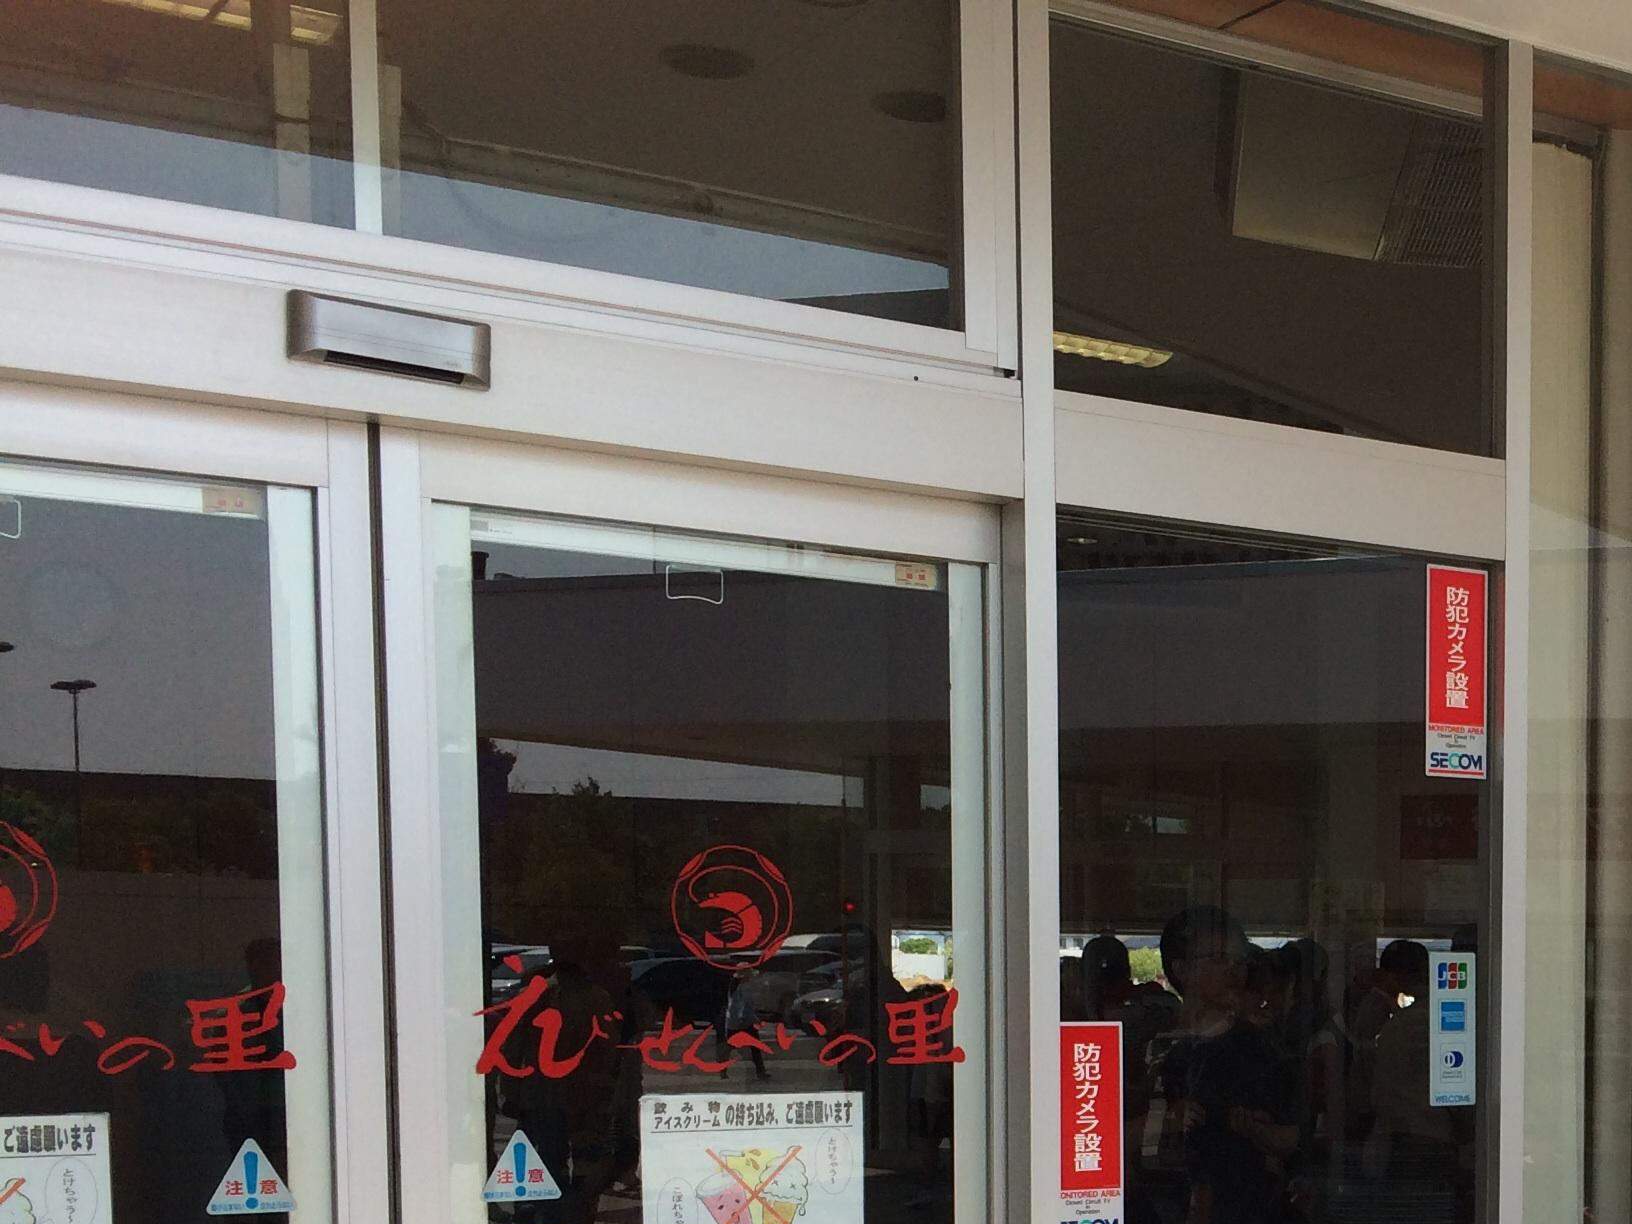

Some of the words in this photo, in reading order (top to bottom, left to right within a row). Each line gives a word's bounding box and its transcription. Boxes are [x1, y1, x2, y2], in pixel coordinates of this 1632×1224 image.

[1446, 586, 1470, 709] 防犯カメラ設置
[1430, 752, 1482, 770] SECOM
[472, 955, 966, 1078] えびせんべいの里
[1073, 1043, 1103, 1173] 防犯カメラ設置
[654, 1115, 720, 1129] アイスクリーム
[4, 1124, 96, 1153] ご遠慮願います
[225, 1179, 278, 1196] 注意
[497, 1168, 544, 1184] 注意
